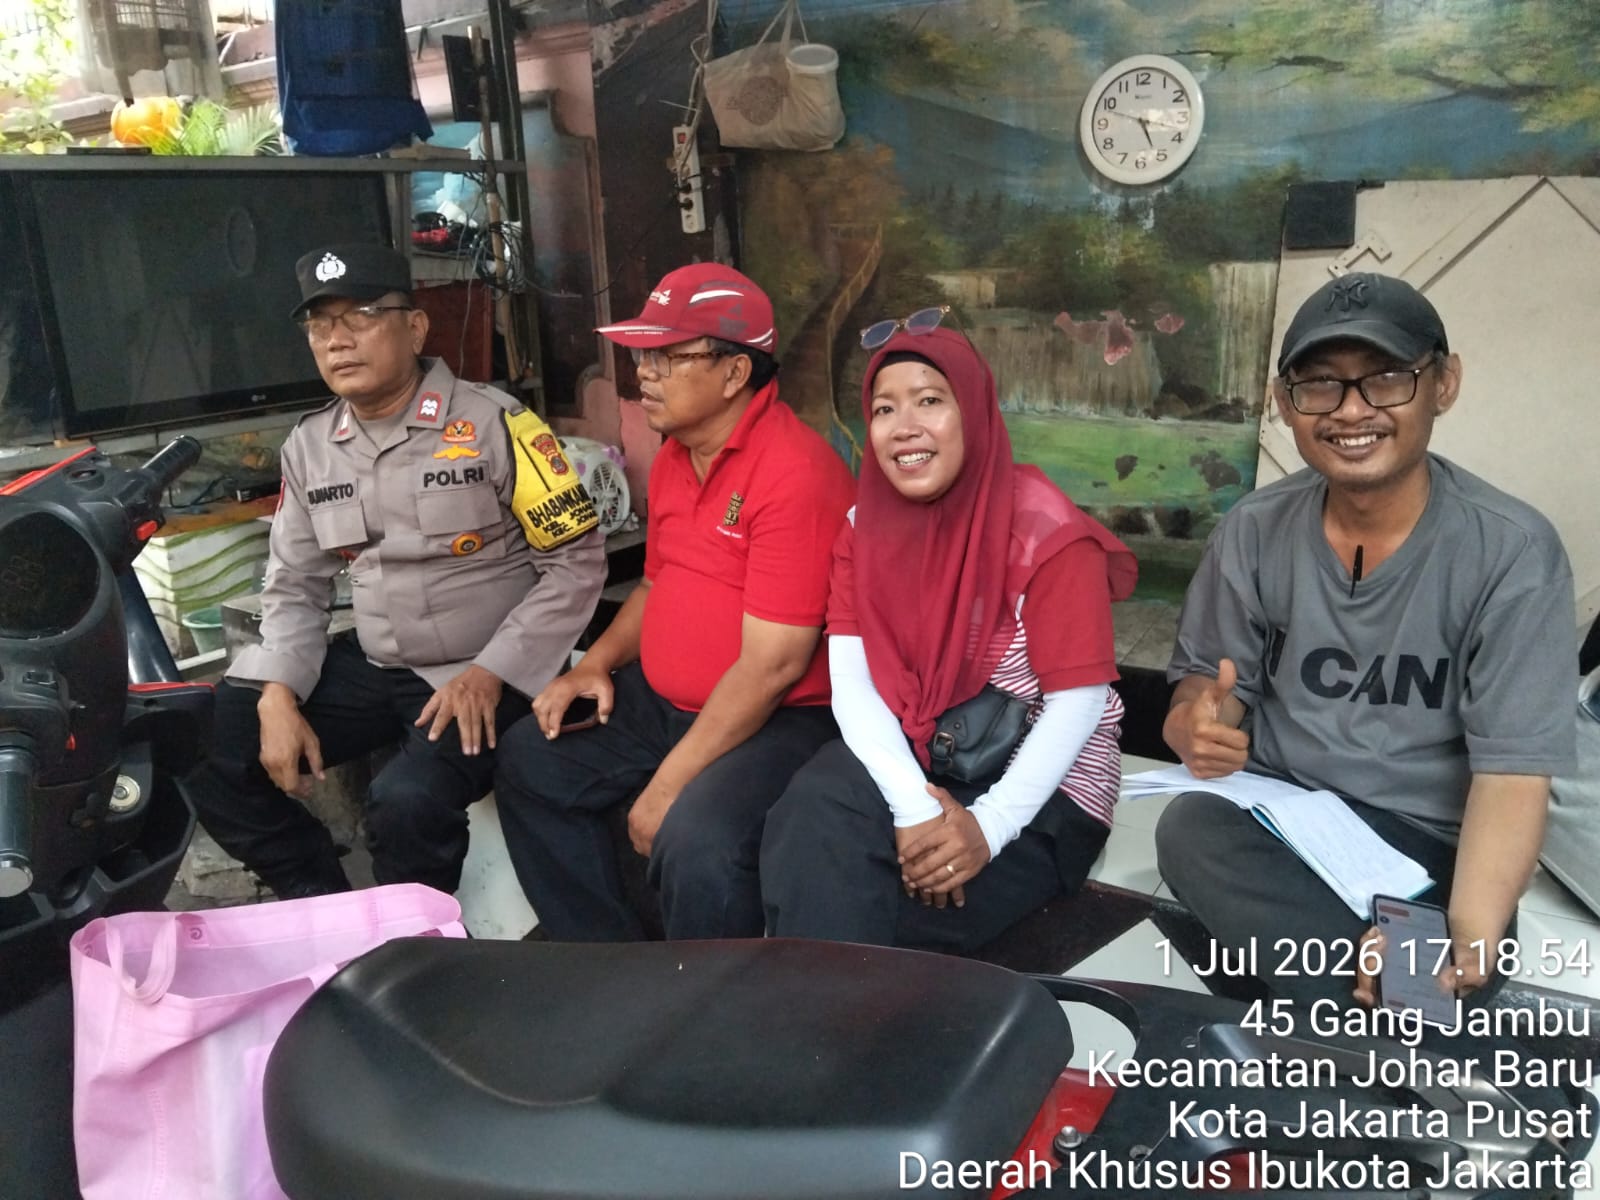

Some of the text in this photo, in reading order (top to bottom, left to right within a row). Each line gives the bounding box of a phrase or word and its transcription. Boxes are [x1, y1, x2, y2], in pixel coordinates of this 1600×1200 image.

[1136, 72, 1151, 86] 12
[1163, 76, 1167, 88] 1
[1119, 80, 1129, 93] 11
[1172, 90, 1185, 103] 2
[1103, 97, 1117, 110] 10
[1177, 111, 1189, 124] 3
[1097, 118, 1109, 131] 9
[1103, 137, 1114, 150] 8
[1171, 131, 1184, 144] 4
[1117, 152, 1129, 165] 7
[1156, 149, 1168, 162] 5
[1135, 156, 1147, 170] 6
[423, 466, 485, 488] POLRI
[1301, 647, 1450, 709] CAN
